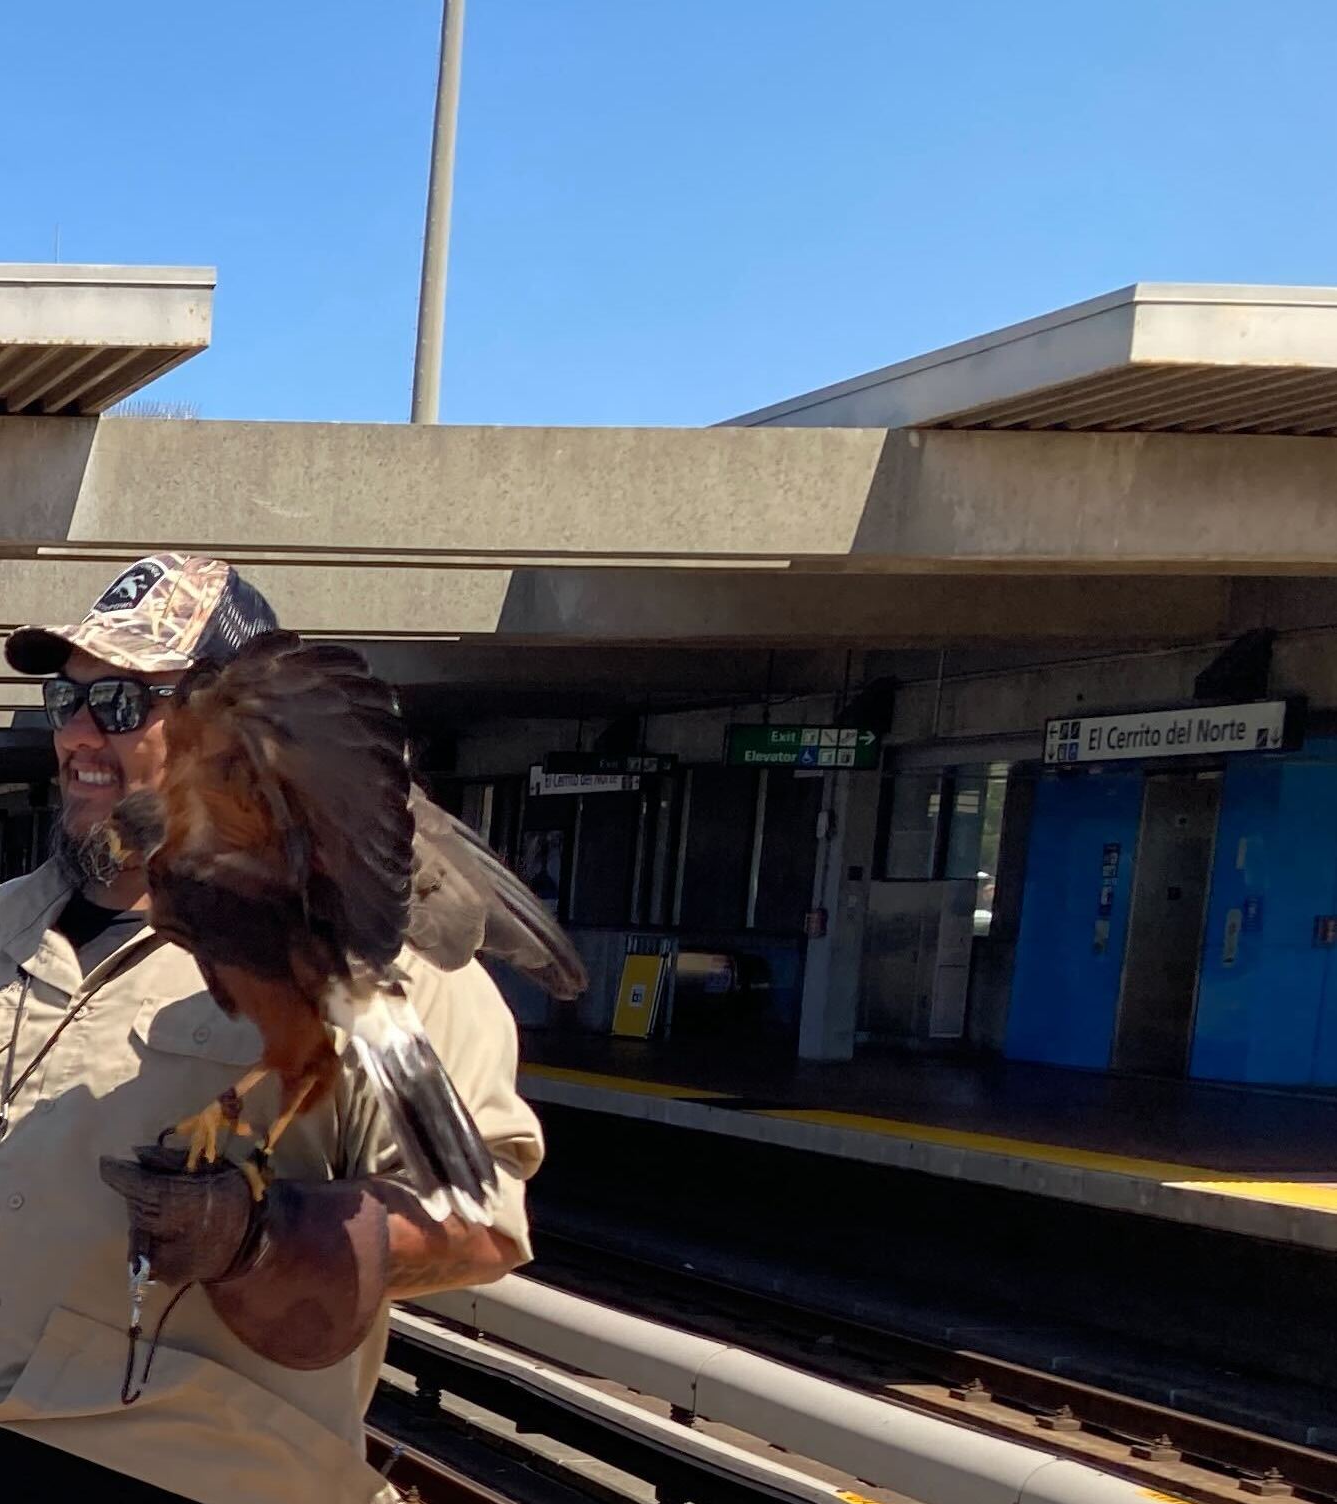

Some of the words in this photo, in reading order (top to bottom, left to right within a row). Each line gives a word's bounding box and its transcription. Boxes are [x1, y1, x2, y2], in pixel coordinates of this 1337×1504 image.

[771, 730, 797, 742] Exit
[1088, 727, 1103, 750] El
[1107, 723, 1161, 750] Cerrito
[1166, 719, 1192, 745] del
[1197, 719, 1246, 743] Norte
[745, 750, 797, 762] Elevator
